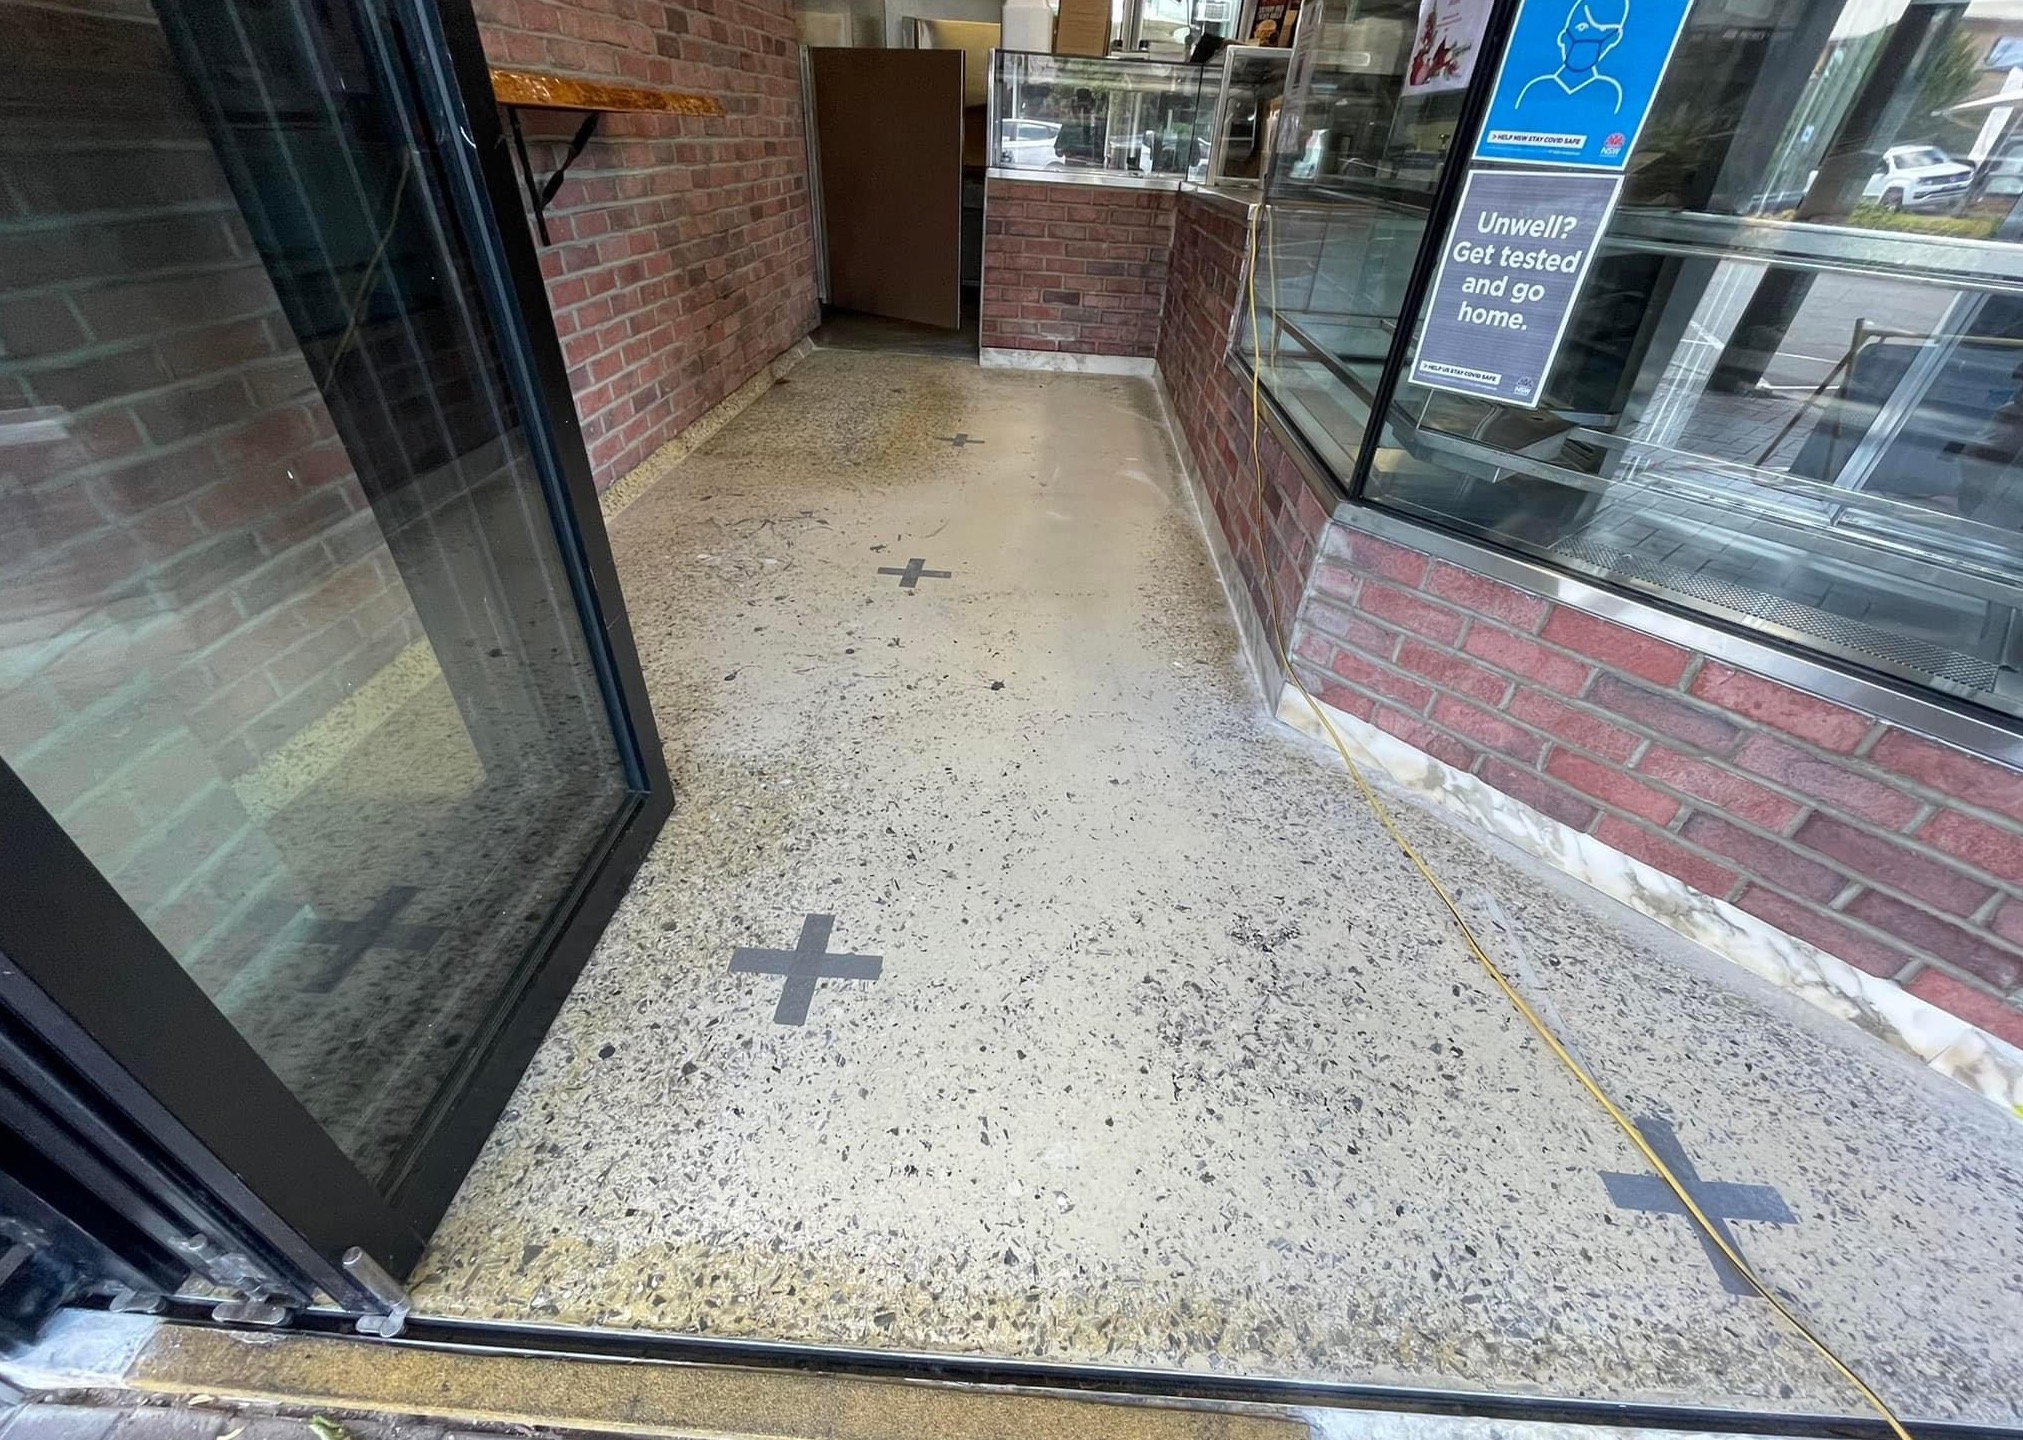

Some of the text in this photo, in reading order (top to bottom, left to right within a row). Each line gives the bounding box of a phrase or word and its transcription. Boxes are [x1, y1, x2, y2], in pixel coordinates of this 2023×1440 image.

[1543, 136, 1563, 144] COVID
[1564, 137, 1581, 145] SAFE
[1600, 147, 1621, 155] NSW
[1477, 211, 1577, 239] Unwell?
[1452, 241, 1583, 273] Get tested
[1461, 275, 1546, 304] and go
[1457, 300, 1527, 331] home.
[1464, 370, 1480, 378] COVID
[1481, 374, 1497, 382] SAFE
[1515, 387, 1532, 395] NSW
